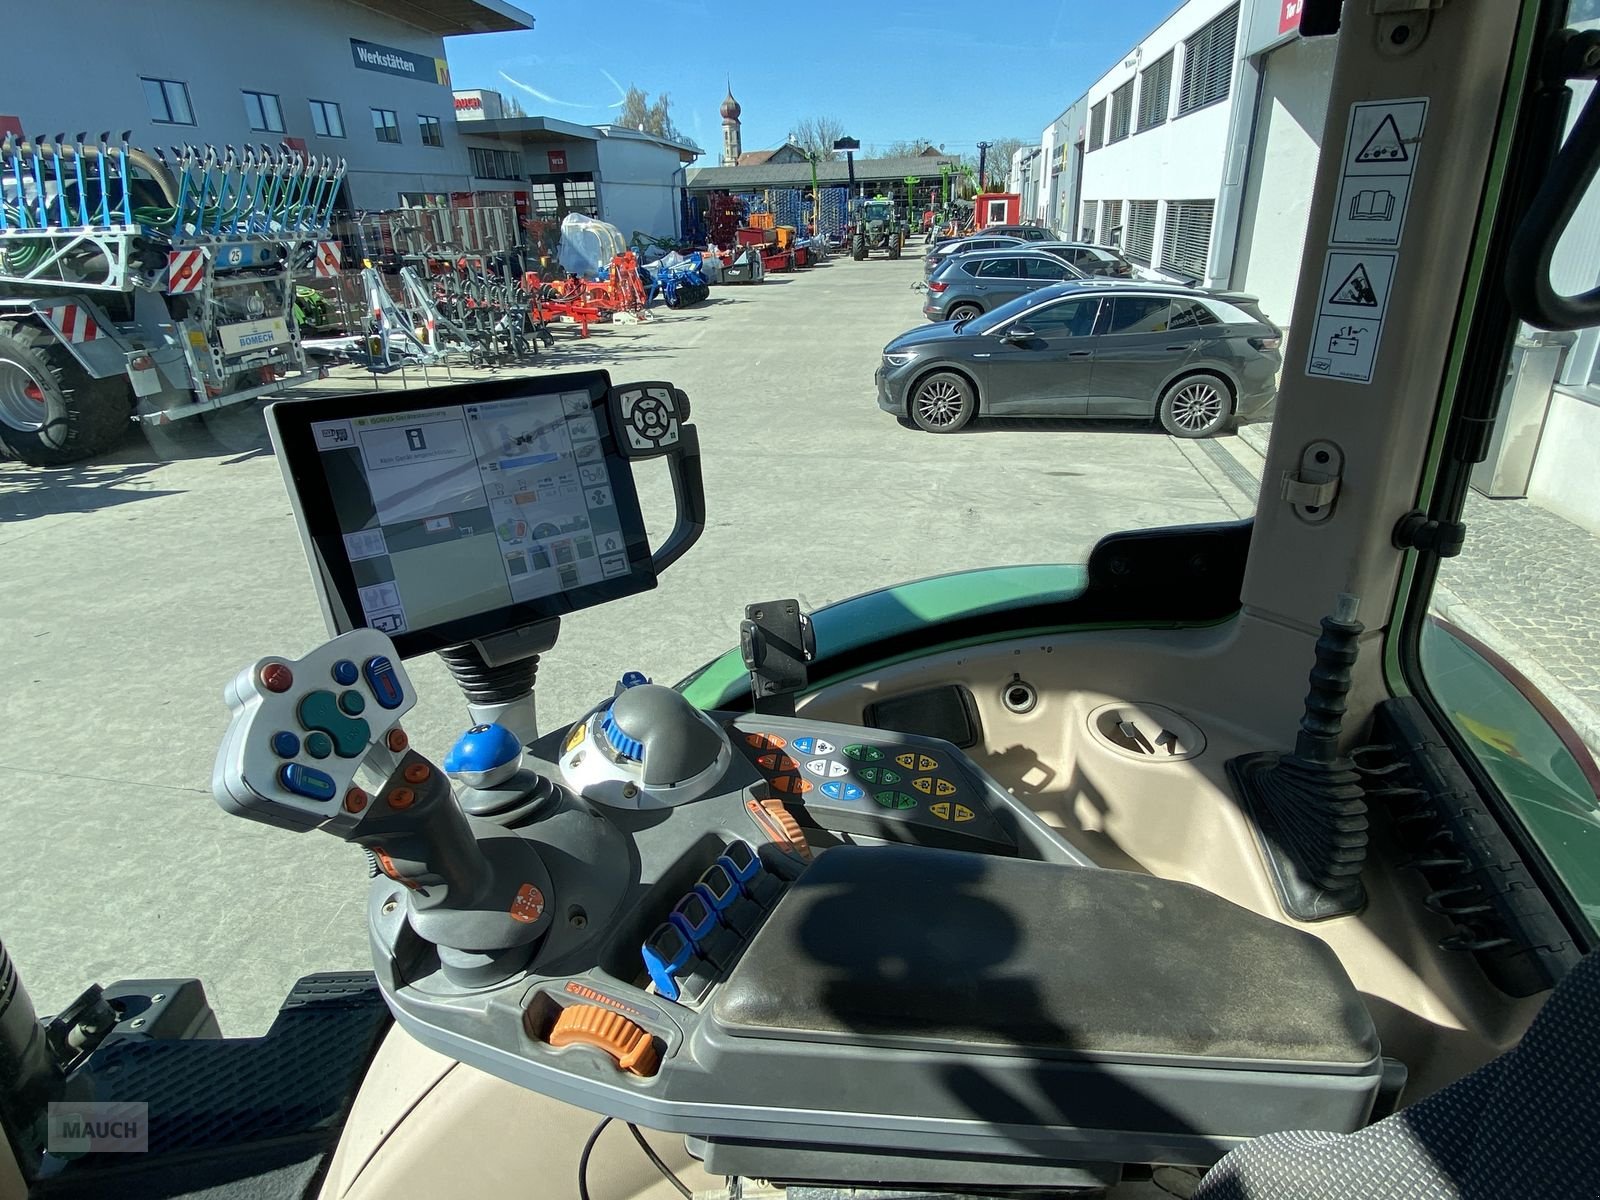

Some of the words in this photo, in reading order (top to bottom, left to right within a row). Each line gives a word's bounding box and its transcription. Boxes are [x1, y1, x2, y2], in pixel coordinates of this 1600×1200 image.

[357, 46, 415, 72] Werkstätten
[454, 97, 482, 110] AUCH
[231, 250, 240, 262] 25
[240, 332, 274, 347] BOMECH
